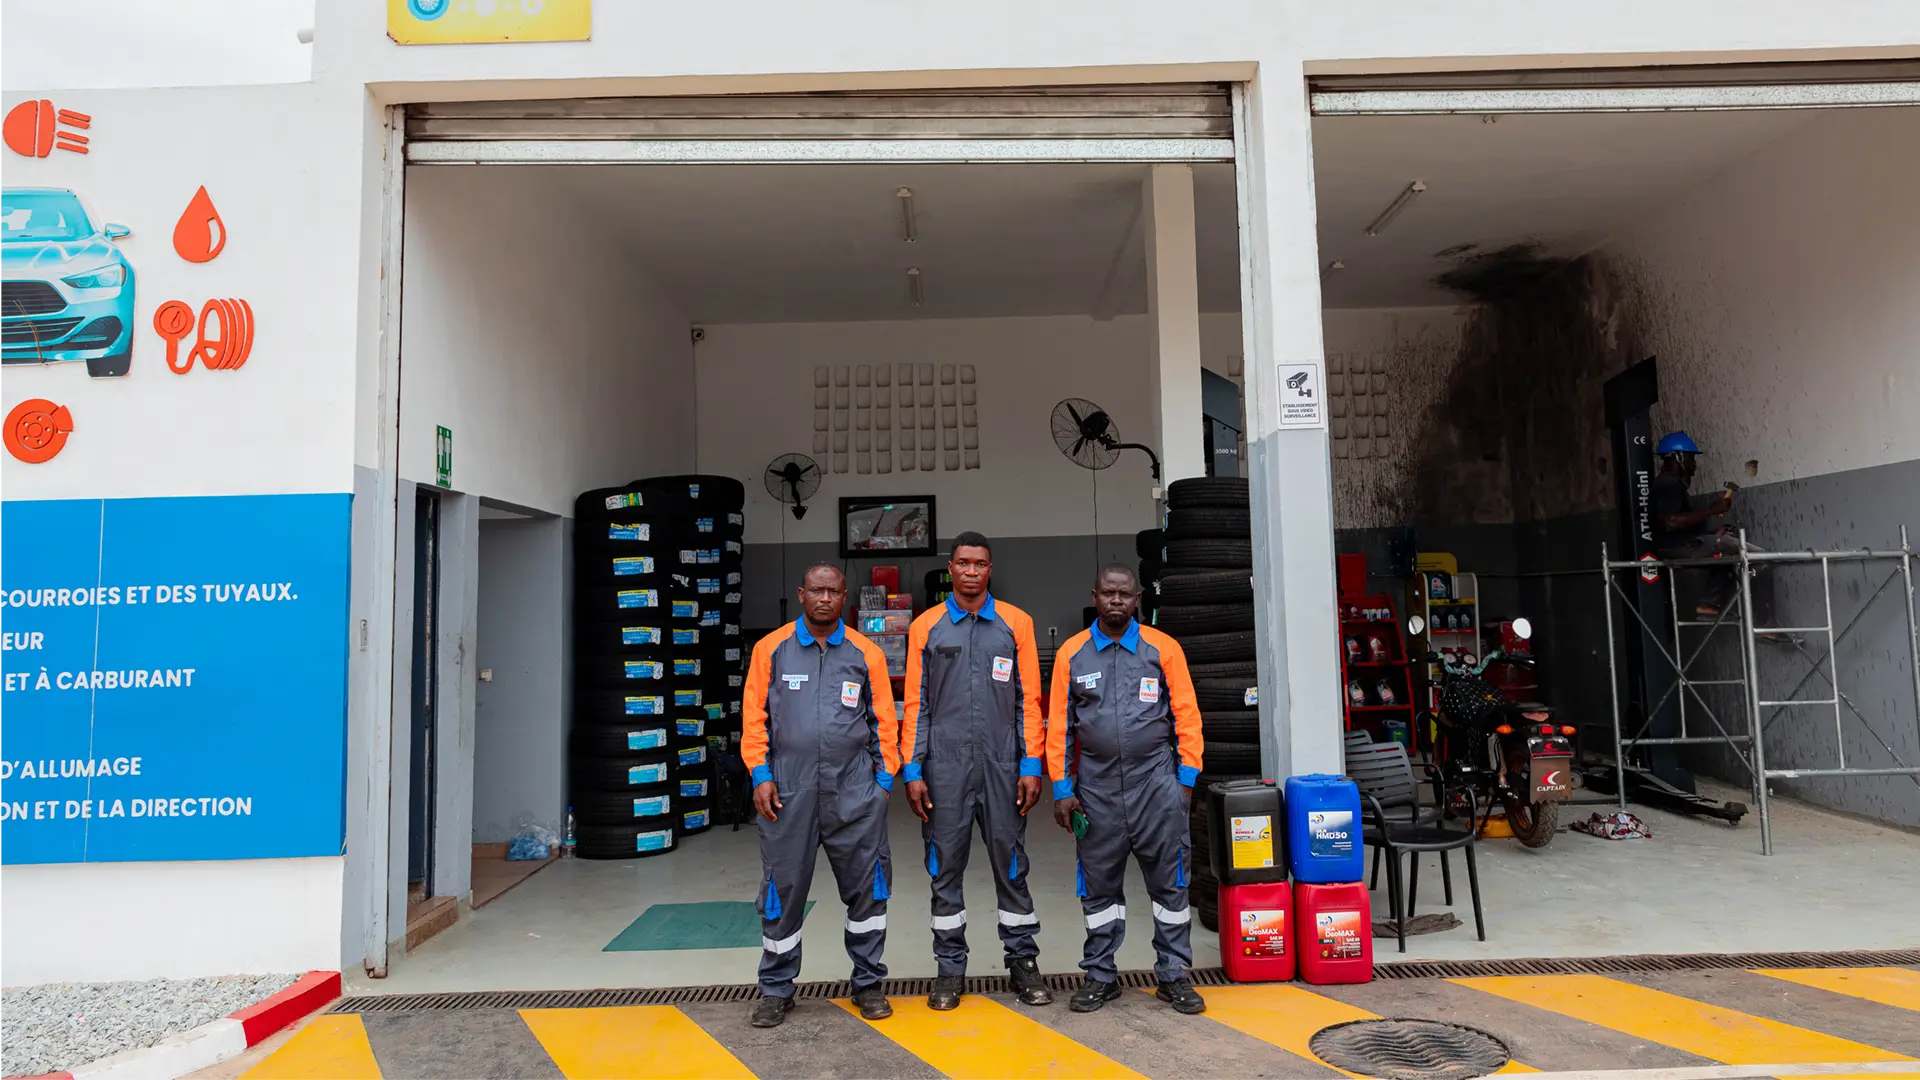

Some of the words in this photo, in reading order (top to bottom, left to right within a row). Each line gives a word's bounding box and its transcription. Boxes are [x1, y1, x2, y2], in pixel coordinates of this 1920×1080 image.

[1636, 471, 1652, 541] ATH-Heinl
[126, 586, 151, 604] ET
[156, 585, 197, 603] DES
[202, 583, 298, 602] TUYAUX.
[5, 672, 31, 691] ET
[35, 666, 51, 690] À
[56, 668, 195, 690] CARBURANT
[1537, 784, 1566, 792] CAPTAIN
[34, 801, 59, 820] ET
[65, 799, 93, 819] DE
[98, 799, 125, 818] LA
[131, 797, 252, 817] DIRECTION
